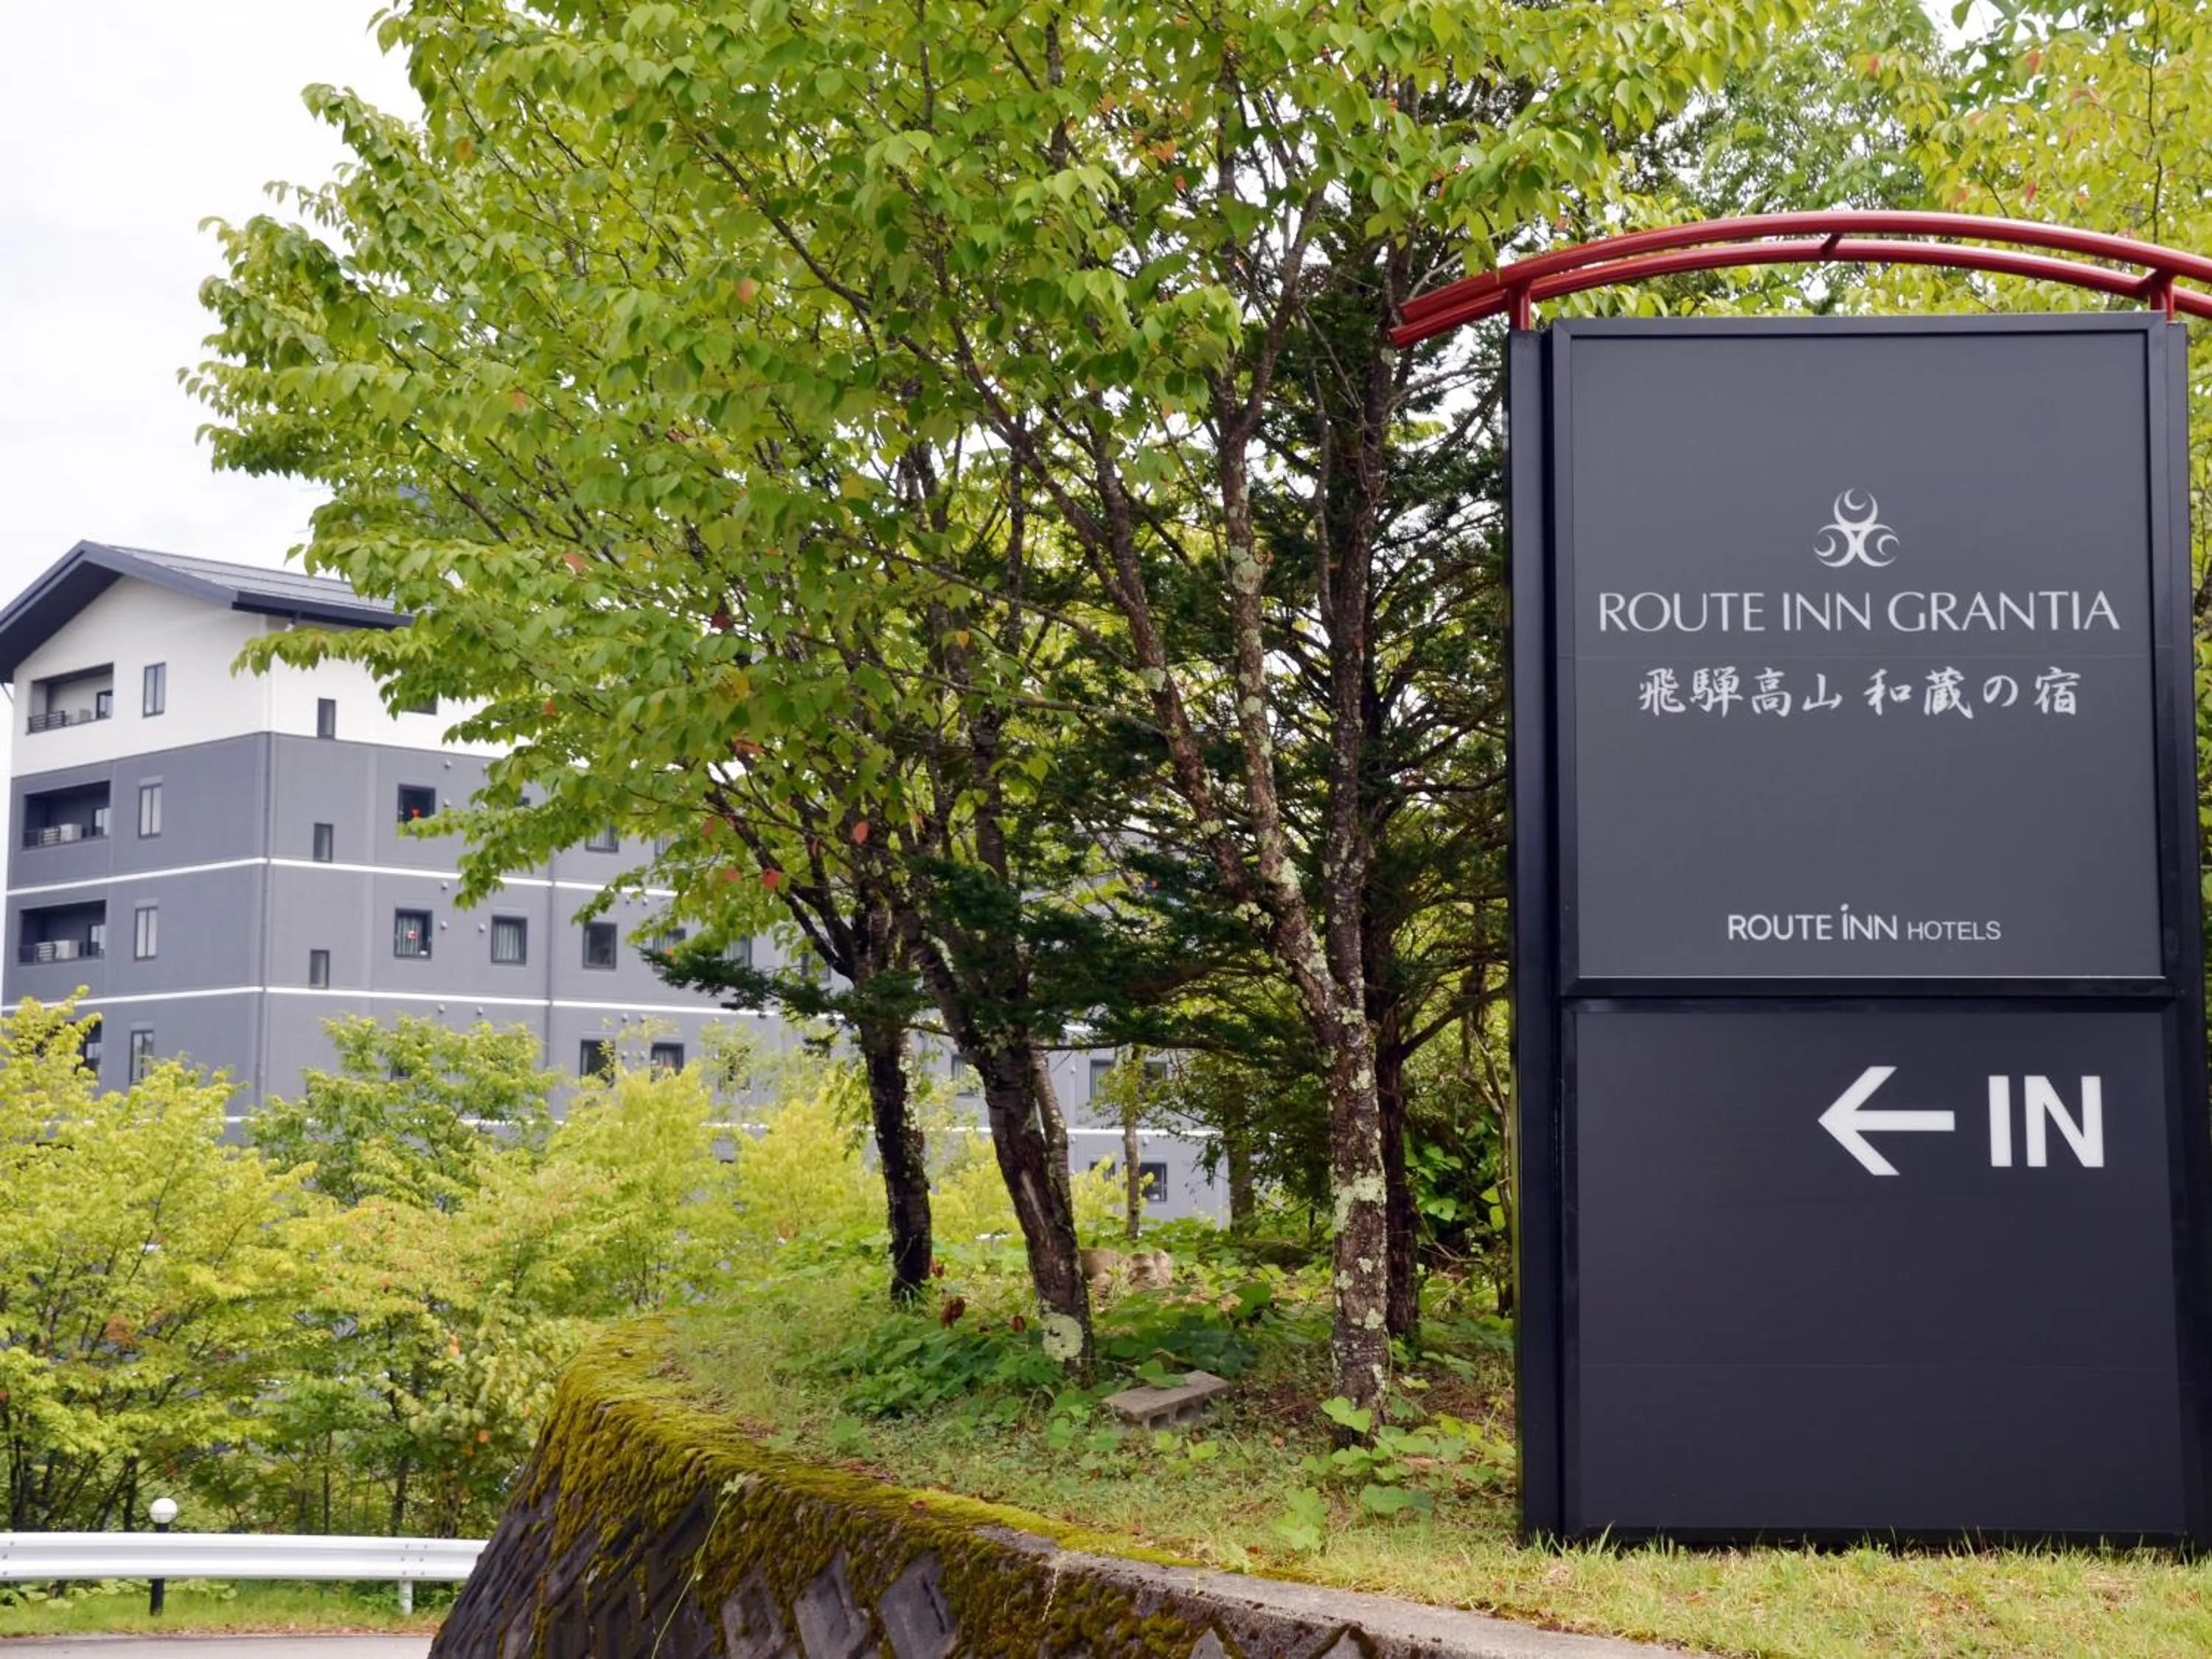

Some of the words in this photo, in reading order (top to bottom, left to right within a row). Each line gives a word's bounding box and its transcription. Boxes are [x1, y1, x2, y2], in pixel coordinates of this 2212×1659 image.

[1599, 591, 1765, 633] ROUTE
[1781, 591, 1871, 632] INN
[1887, 590, 2121, 632] GRANTIA
[1728, 914, 1833, 941] ROUTE
[1907, 919, 2003, 942] HOTELS
[1988, 1075, 2105, 1168] IN
